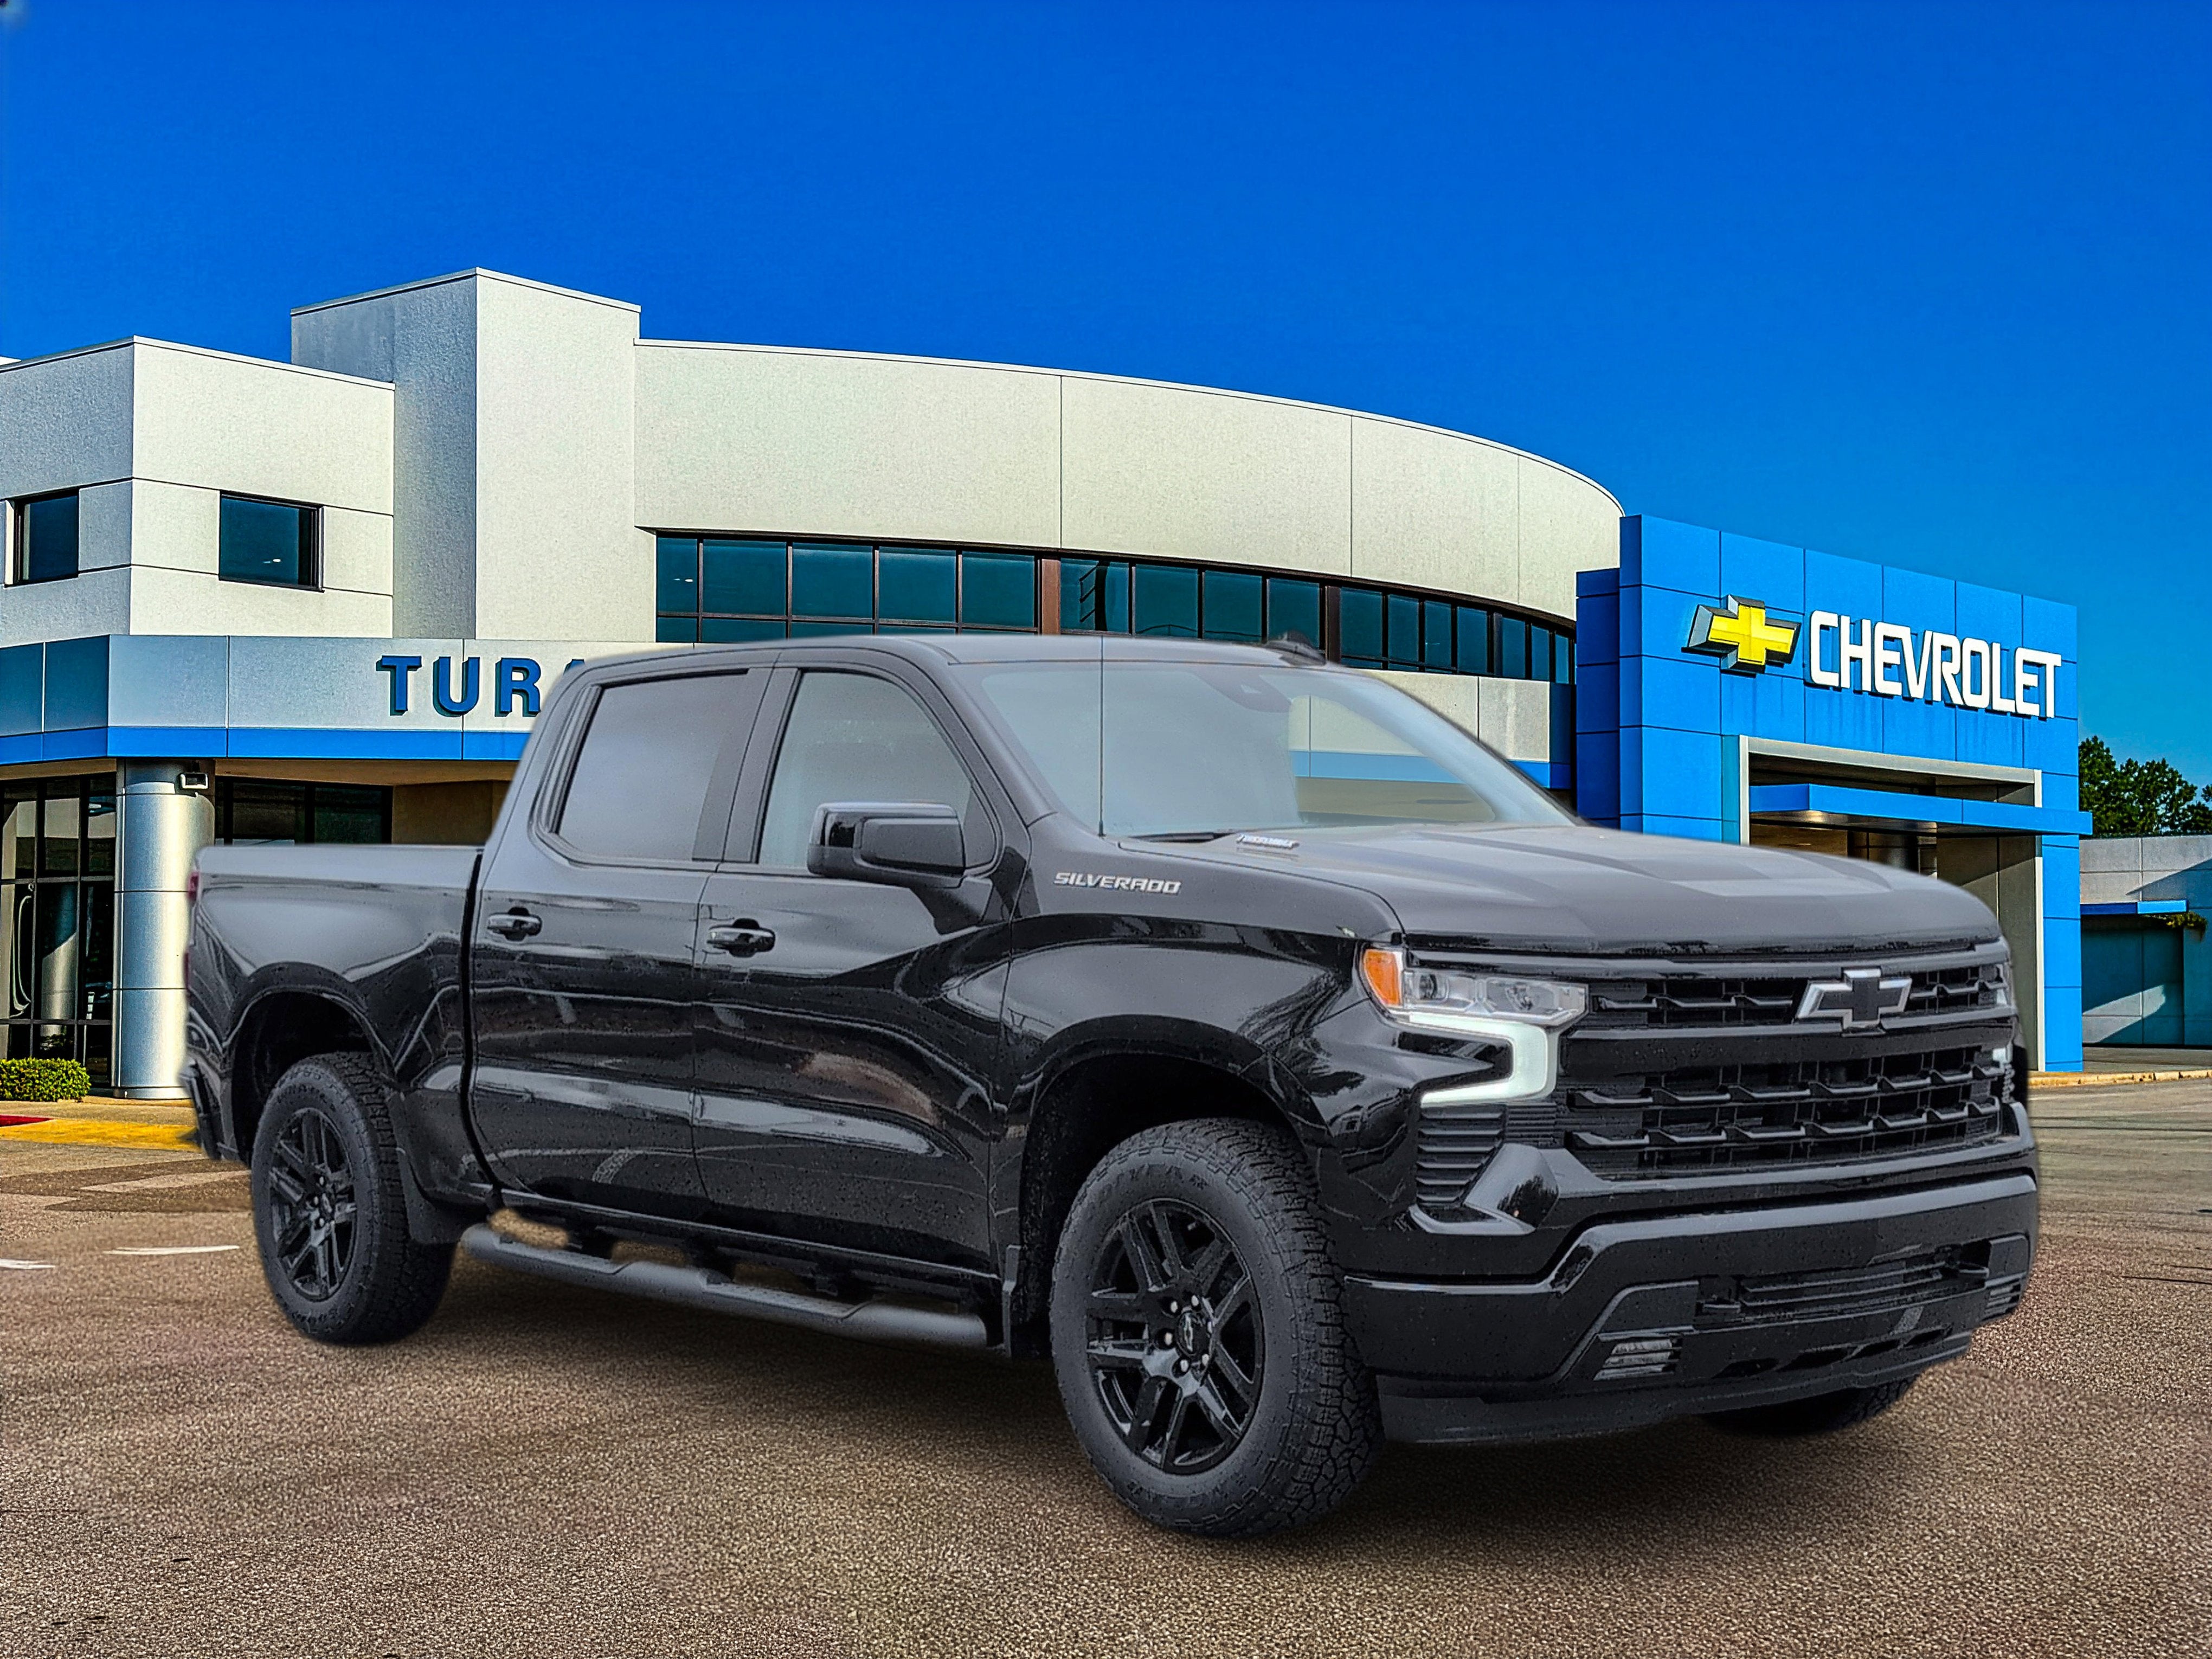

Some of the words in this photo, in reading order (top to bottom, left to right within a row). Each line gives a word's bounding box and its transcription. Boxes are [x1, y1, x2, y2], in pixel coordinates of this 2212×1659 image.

[376, 655, 585, 717] TUR
[1810, 610, 2062, 718] CHEVROLET
[1054, 872, 1182, 895] SILVERADO
